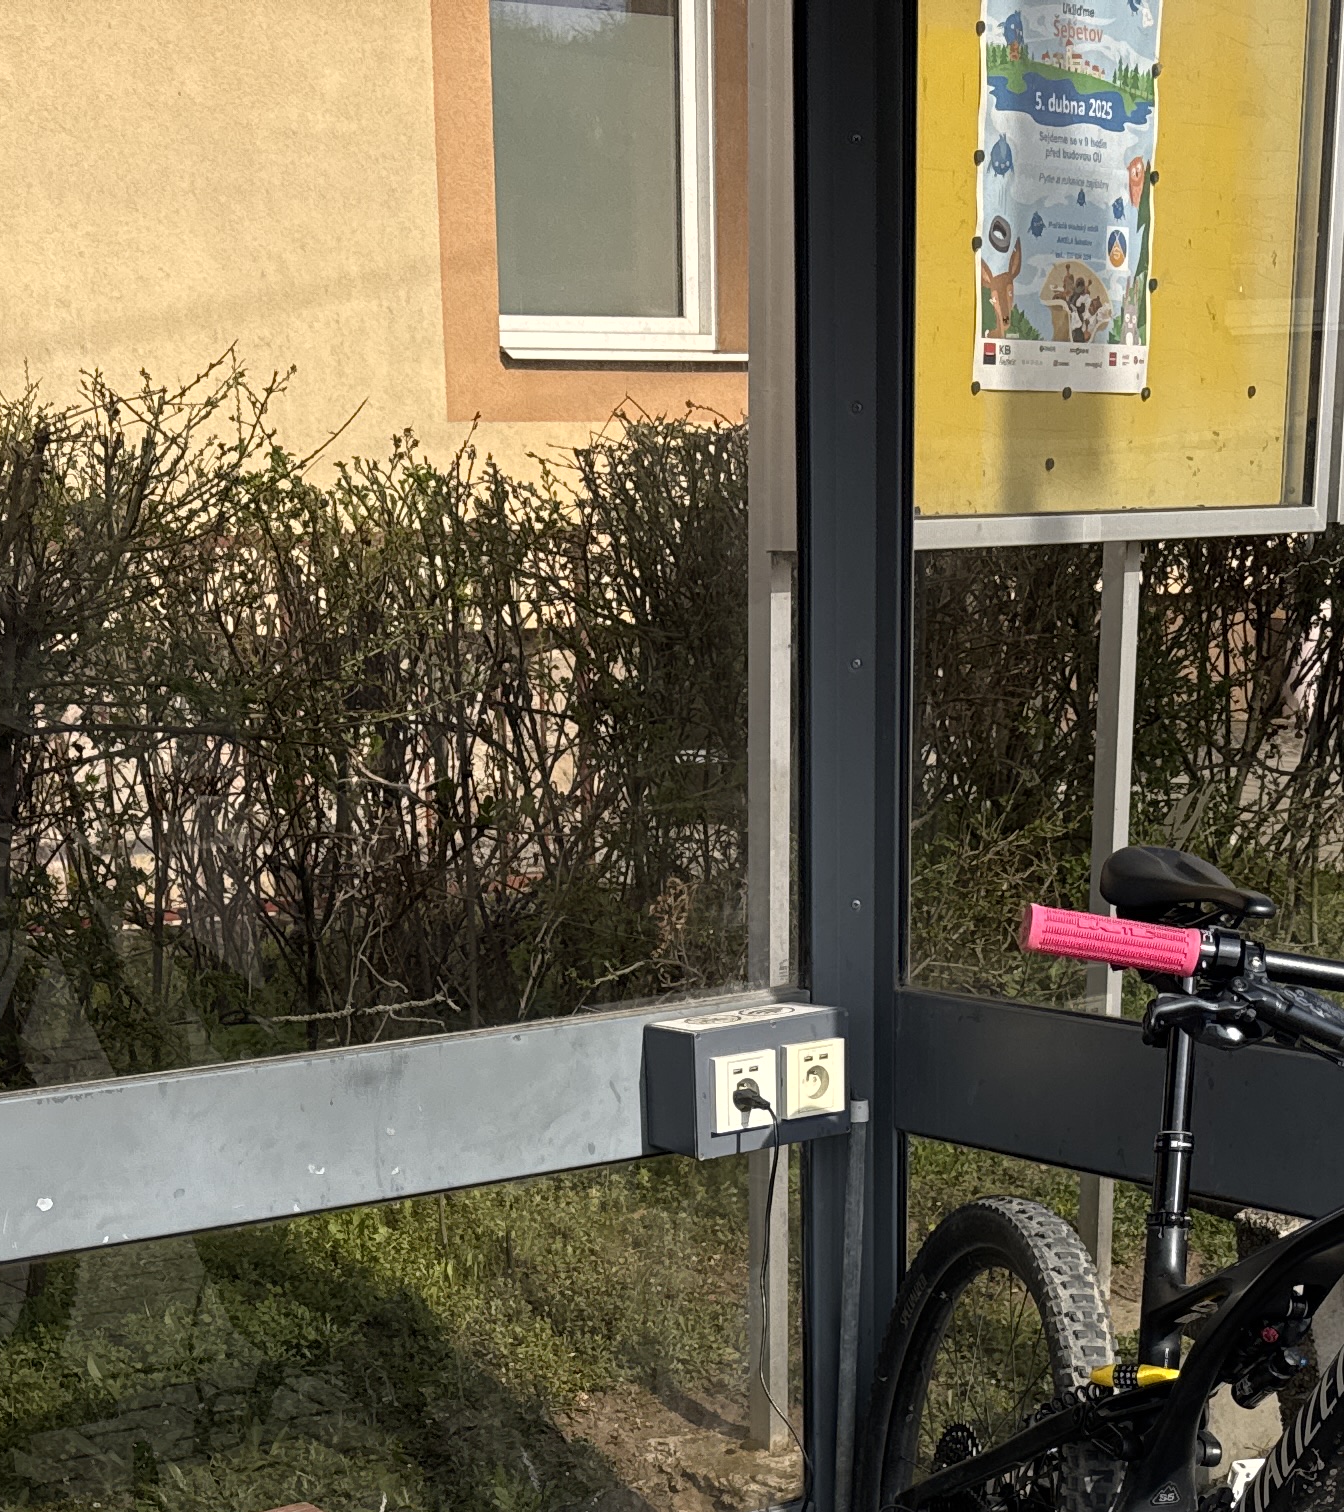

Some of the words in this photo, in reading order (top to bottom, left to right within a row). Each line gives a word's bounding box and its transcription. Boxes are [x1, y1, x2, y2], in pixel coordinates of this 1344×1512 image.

[1053, 15, 1104, 43] Šebetov
[1035, 92, 1045, 110] 5.
[1048, 93, 1086, 116] dubna
[1088, 98, 1113, 120] 2025
